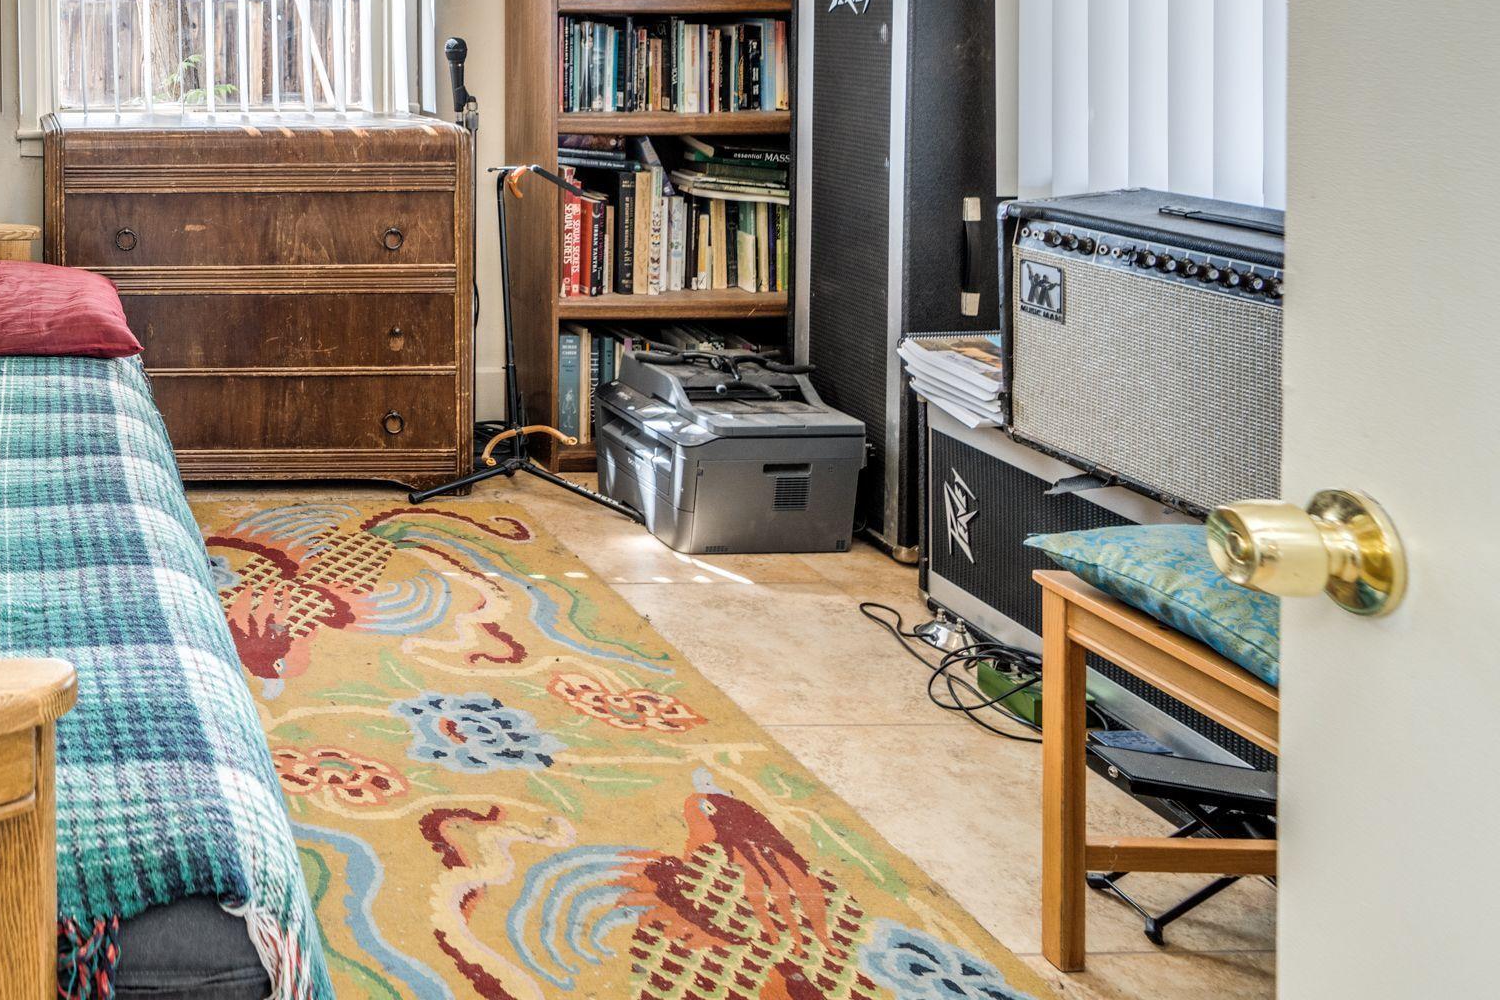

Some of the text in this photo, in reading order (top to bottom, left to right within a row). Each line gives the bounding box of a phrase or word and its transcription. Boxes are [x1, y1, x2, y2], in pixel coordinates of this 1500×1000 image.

[733, 151, 790, 164] essential MASS
[563, 203, 573, 265] SEXUAL SECRETS
[571, 219, 581, 273] SEXUAL SECRETS
[591, 247, 599, 273] TANTRA
[623, 250, 633, 267] ART
[1021, 304, 1062, 322] MUSIC MAN
[590, 352, 600, 374] THE
